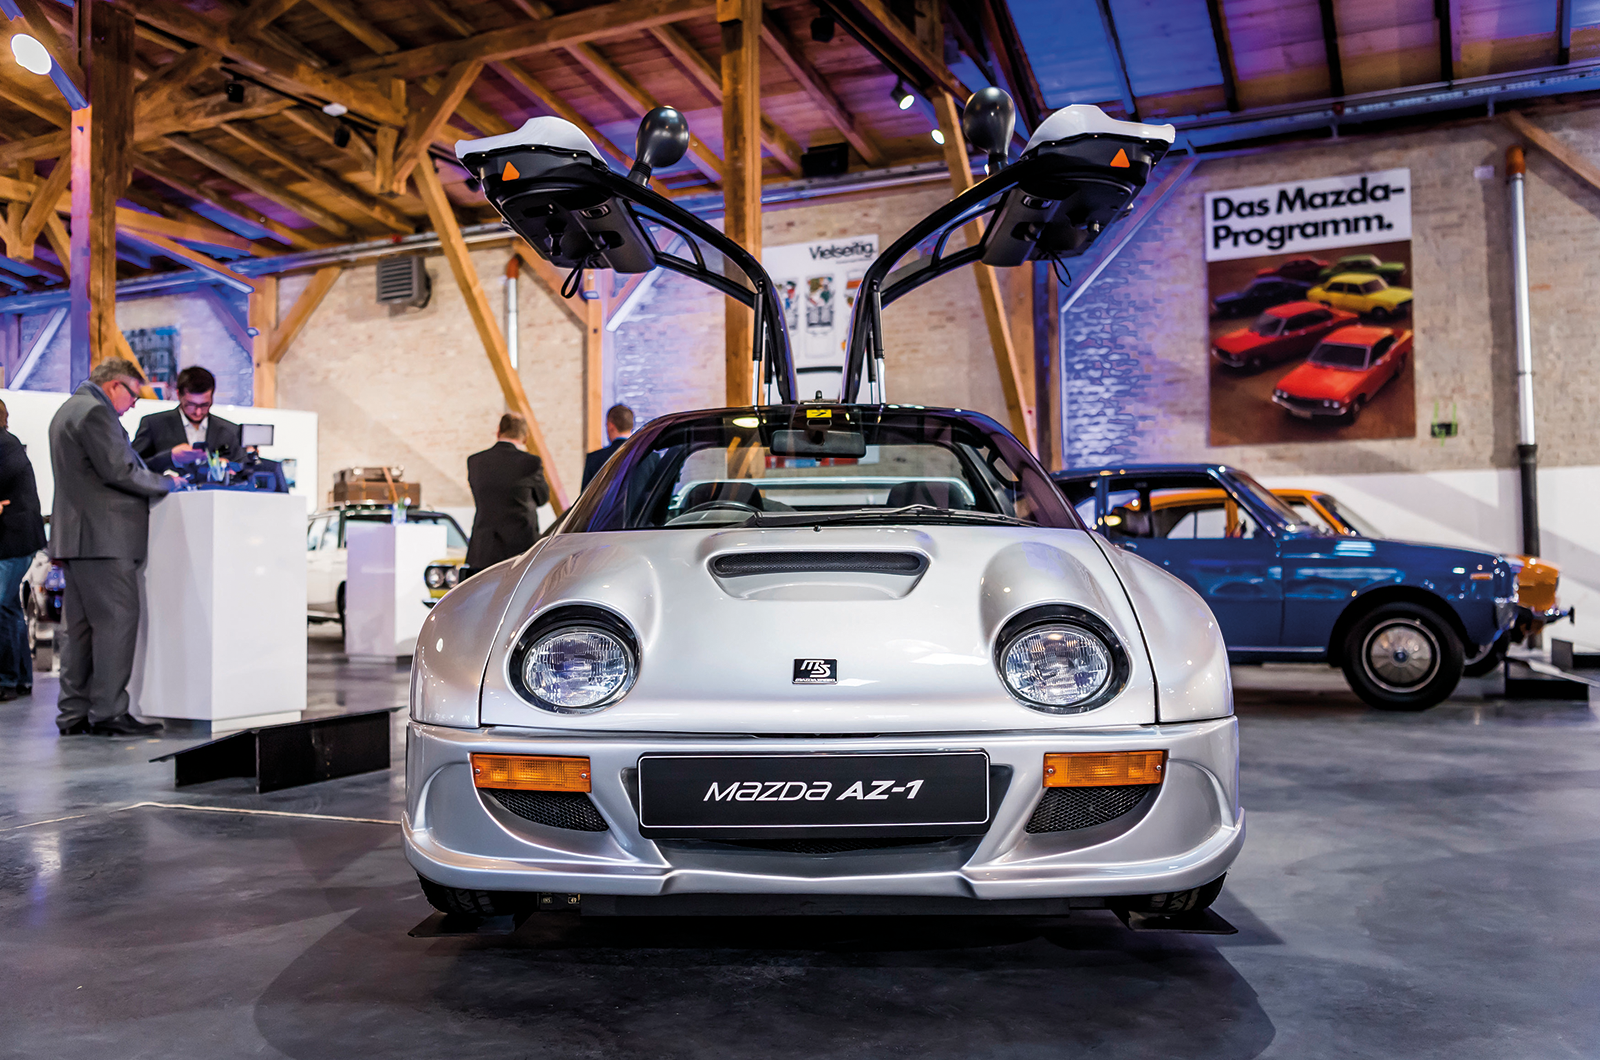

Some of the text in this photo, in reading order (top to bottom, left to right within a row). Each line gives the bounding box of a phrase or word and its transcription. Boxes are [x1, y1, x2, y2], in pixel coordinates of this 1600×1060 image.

[1212, 177, 1405, 221] Das Mazda-
[1213, 213, 1394, 250] Programm.
[836, 779, 925, 801] AZ-1
